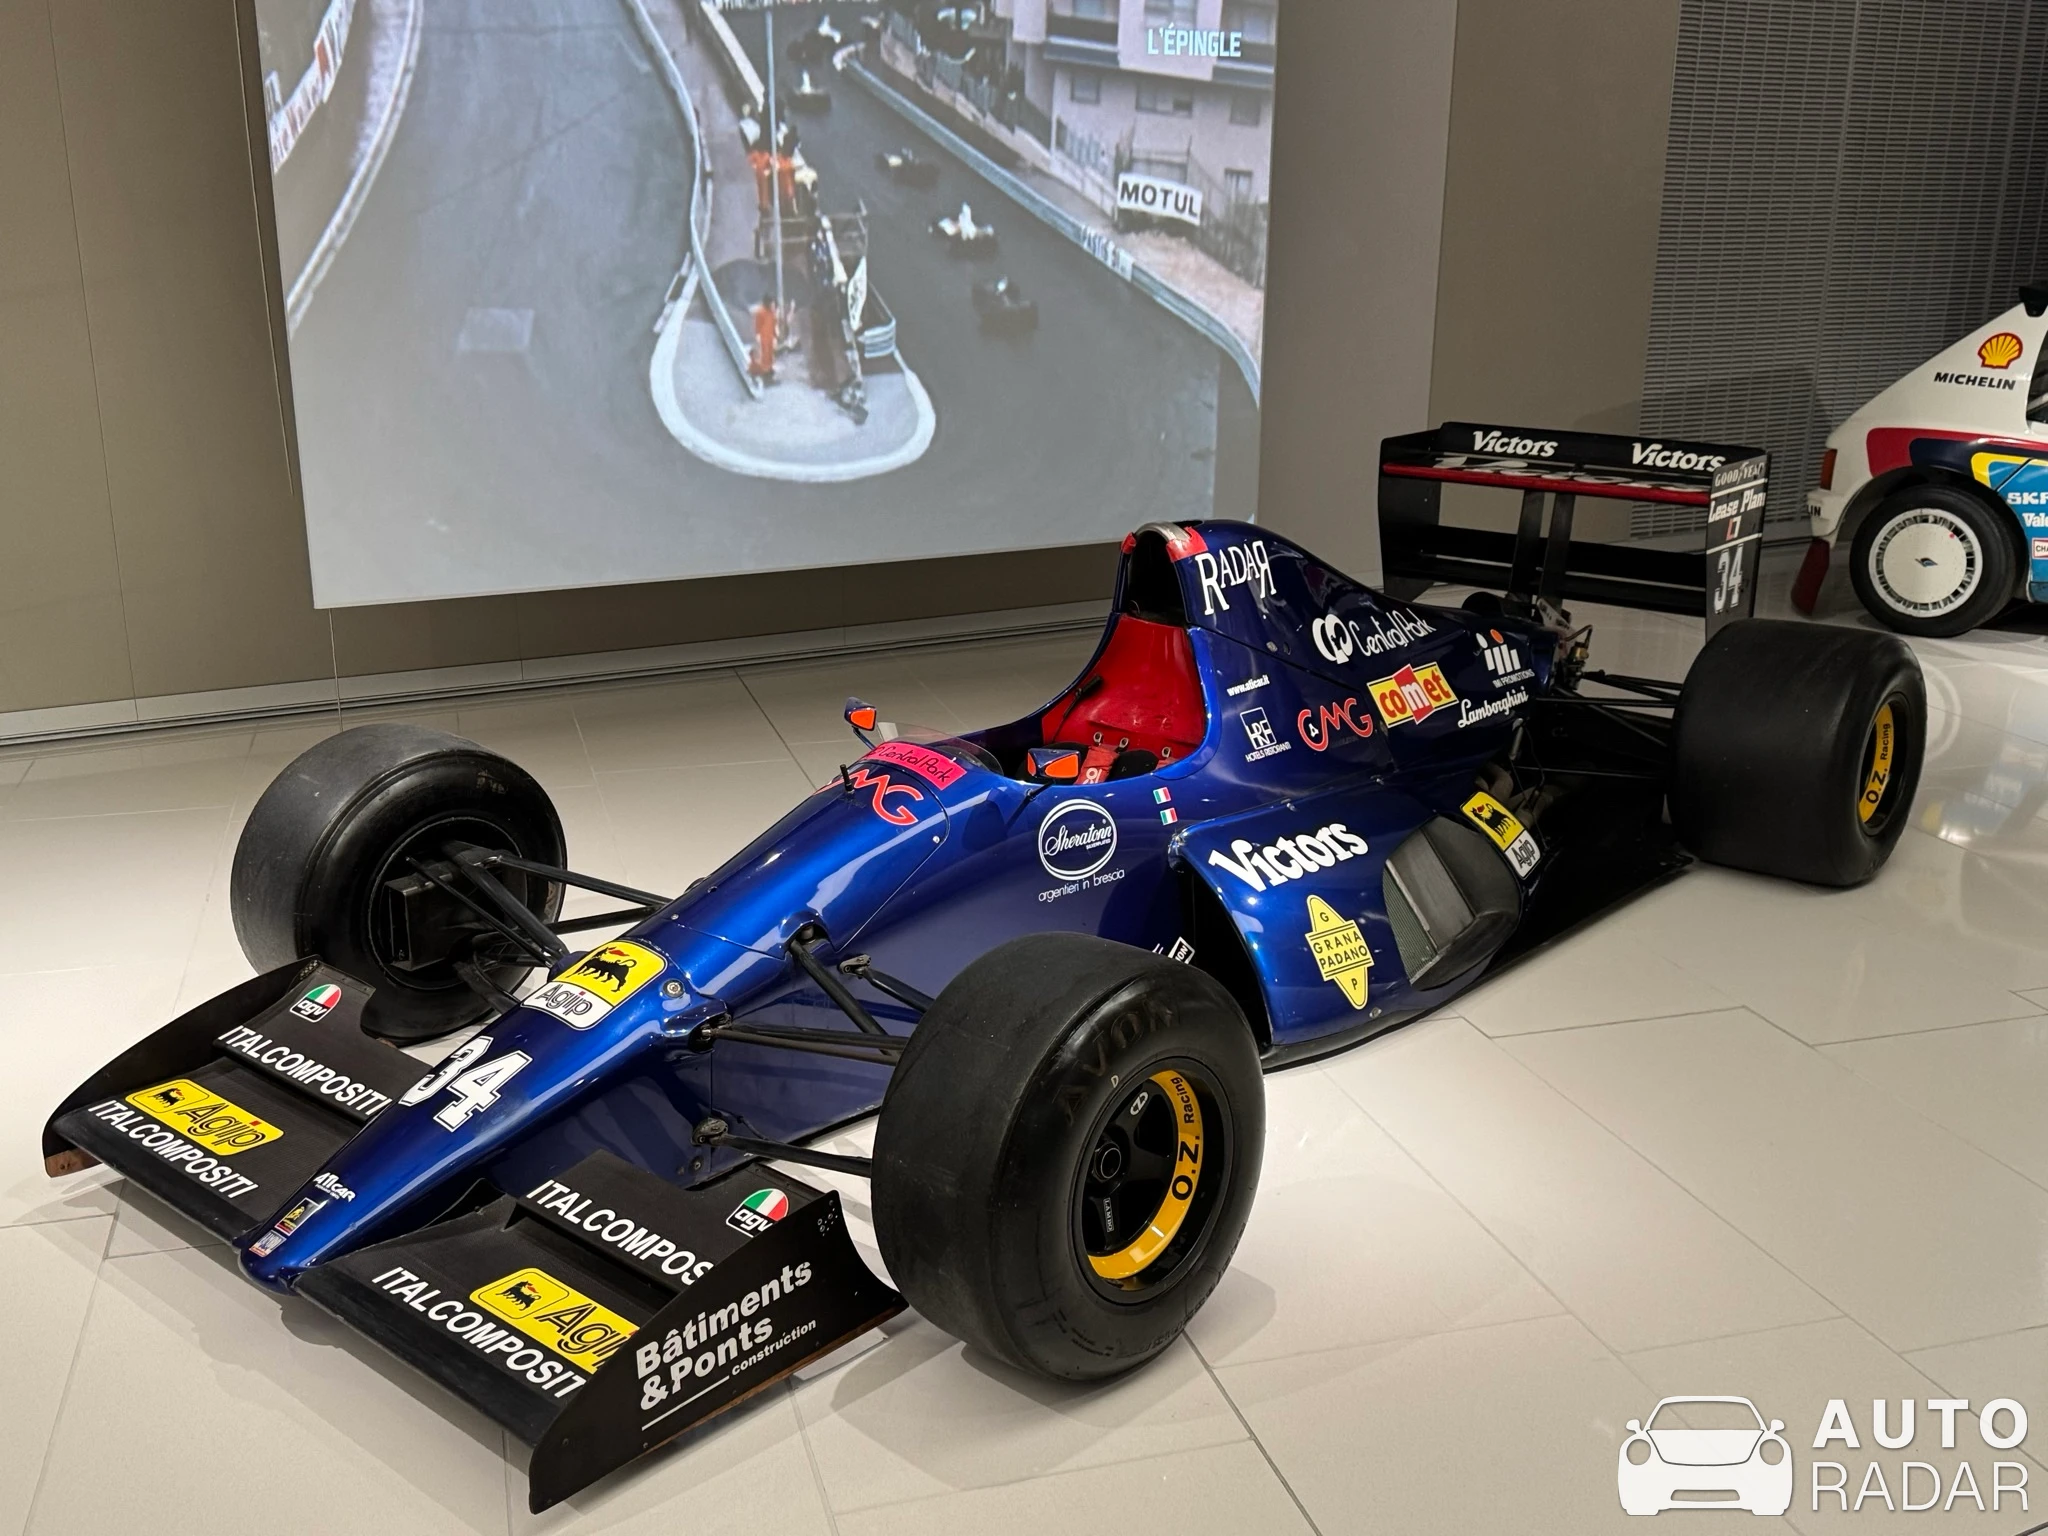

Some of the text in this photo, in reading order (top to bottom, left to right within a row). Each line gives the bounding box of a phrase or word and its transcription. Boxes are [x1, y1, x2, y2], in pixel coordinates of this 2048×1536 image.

[1147, 22, 1242, 58] L'ÉPINGLE
[1120, 181, 1199, 218] MOTUL
[1934, 371, 2016, 391] MICHELIN
[1472, 429, 1559, 458] Victors
[1631, 442, 1726, 473] Victors
[1708, 500, 1740, 524] Lease
[1714, 542, 1744, 615] 34
[1378, 667, 1450, 718] comet
[1457, 685, 1529, 728] Lamborghini
[1880, 722, 1891, 761] Racing
[1208, 823, 1369, 892] Victors
[1514, 838, 1537, 869] Agip
[1038, 868, 1125, 903] argentieri in brescia
[1319, 910, 1329, 923] G
[1312, 931, 1363, 955] GRANA
[1319, 945, 1368, 970] PADANO
[535, 981, 593, 1018] Agip
[1352, 977, 1358, 991] P
[297, 999, 328, 1016] agv
[217, 1025, 393, 1115] ITALCOMPOSITI
[398, 1035, 533, 1133] 34
[1170, 1076, 1195, 1124] Racing
[174, 1101, 267, 1148] Agip
[88, 1100, 259, 1199] ITALCOMPOSITI
[538, 1302, 638, 1369] Agi
[636, 1261, 813, 1380] Bâtiments
[731, 1317, 818, 1377] construction
